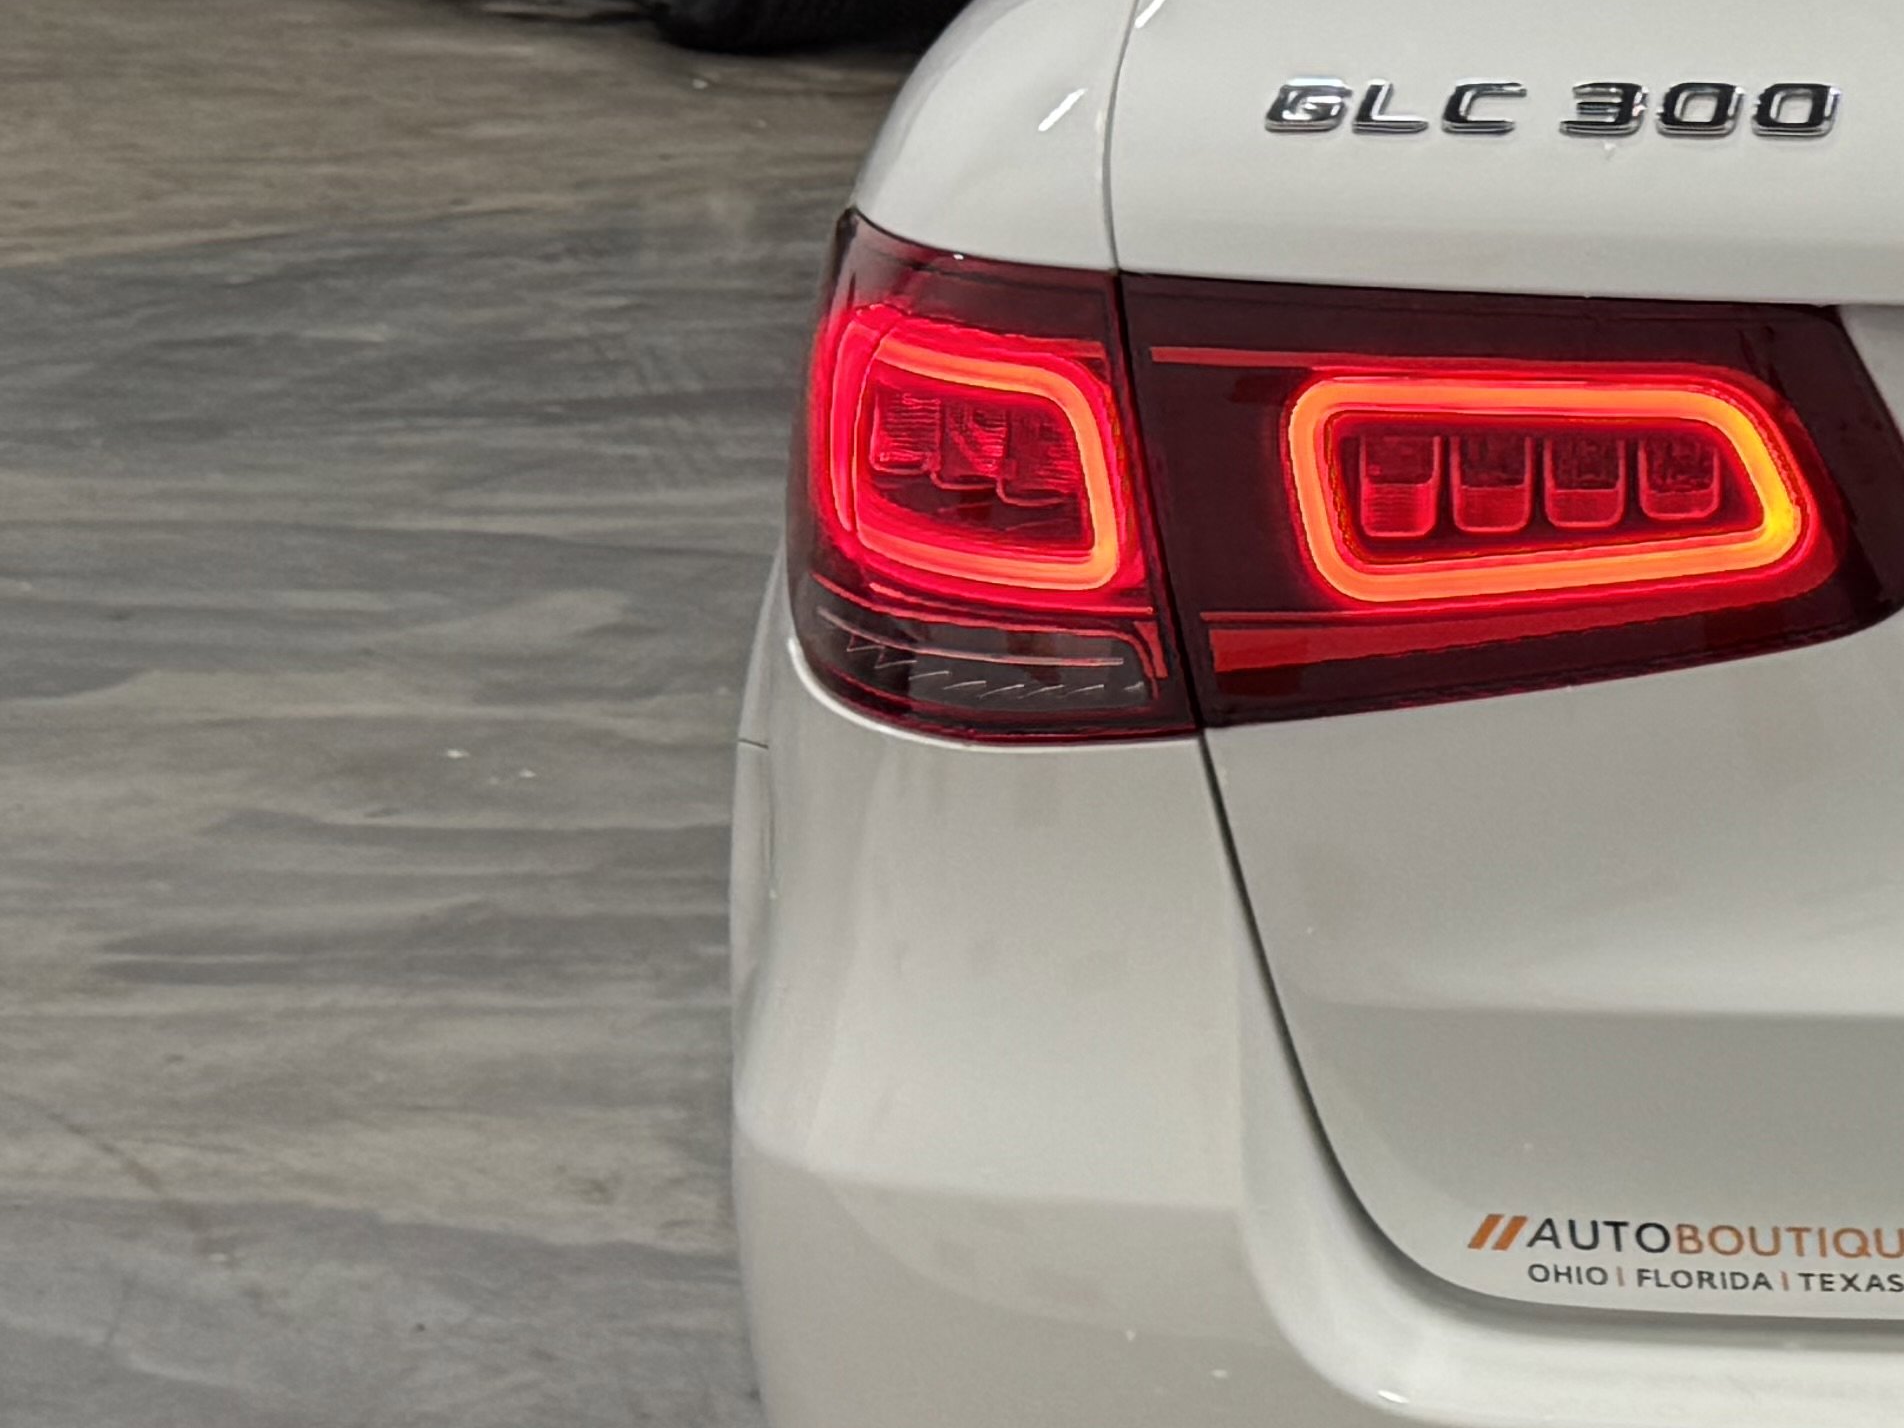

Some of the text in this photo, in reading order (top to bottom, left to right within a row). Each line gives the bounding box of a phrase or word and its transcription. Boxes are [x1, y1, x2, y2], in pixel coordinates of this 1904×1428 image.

[1264, 78, 1841, 138] GLC 300
[1527, 1263, 1904, 1293] OHIO FLORIDA TEXAS
